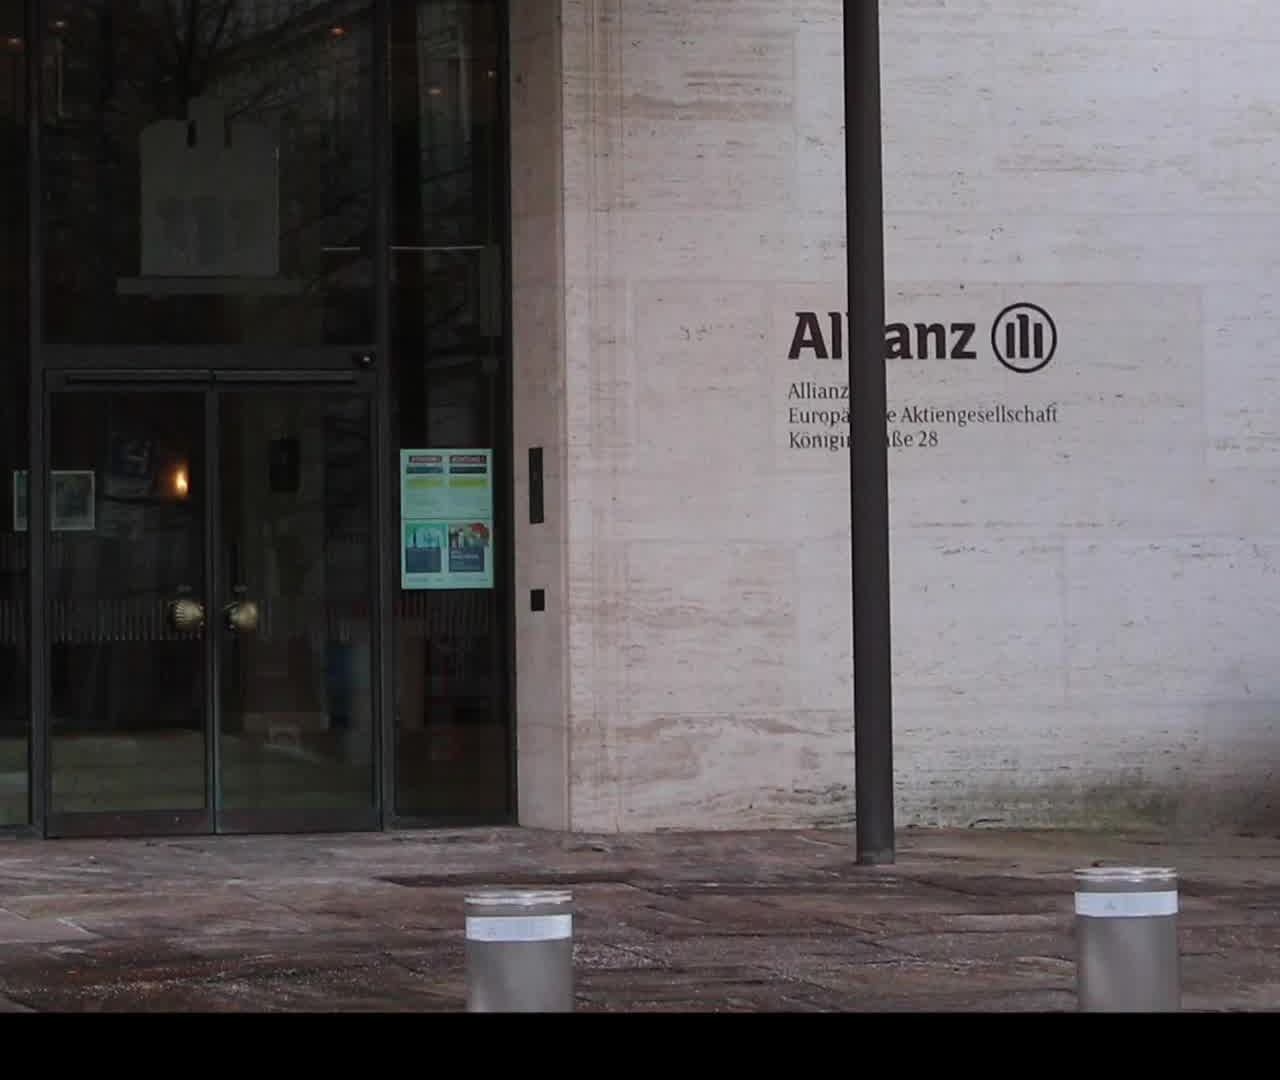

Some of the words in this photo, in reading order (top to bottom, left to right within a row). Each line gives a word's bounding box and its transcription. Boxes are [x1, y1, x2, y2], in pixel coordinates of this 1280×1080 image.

[788, 311, 977, 360] Alanz
[788, 381, 849, 400] Allianz
[788, 406, 897, 427] Europäe
[901, 402, 1058, 427] Aktiengesellschaft
[918, 430, 938, 448] 28
